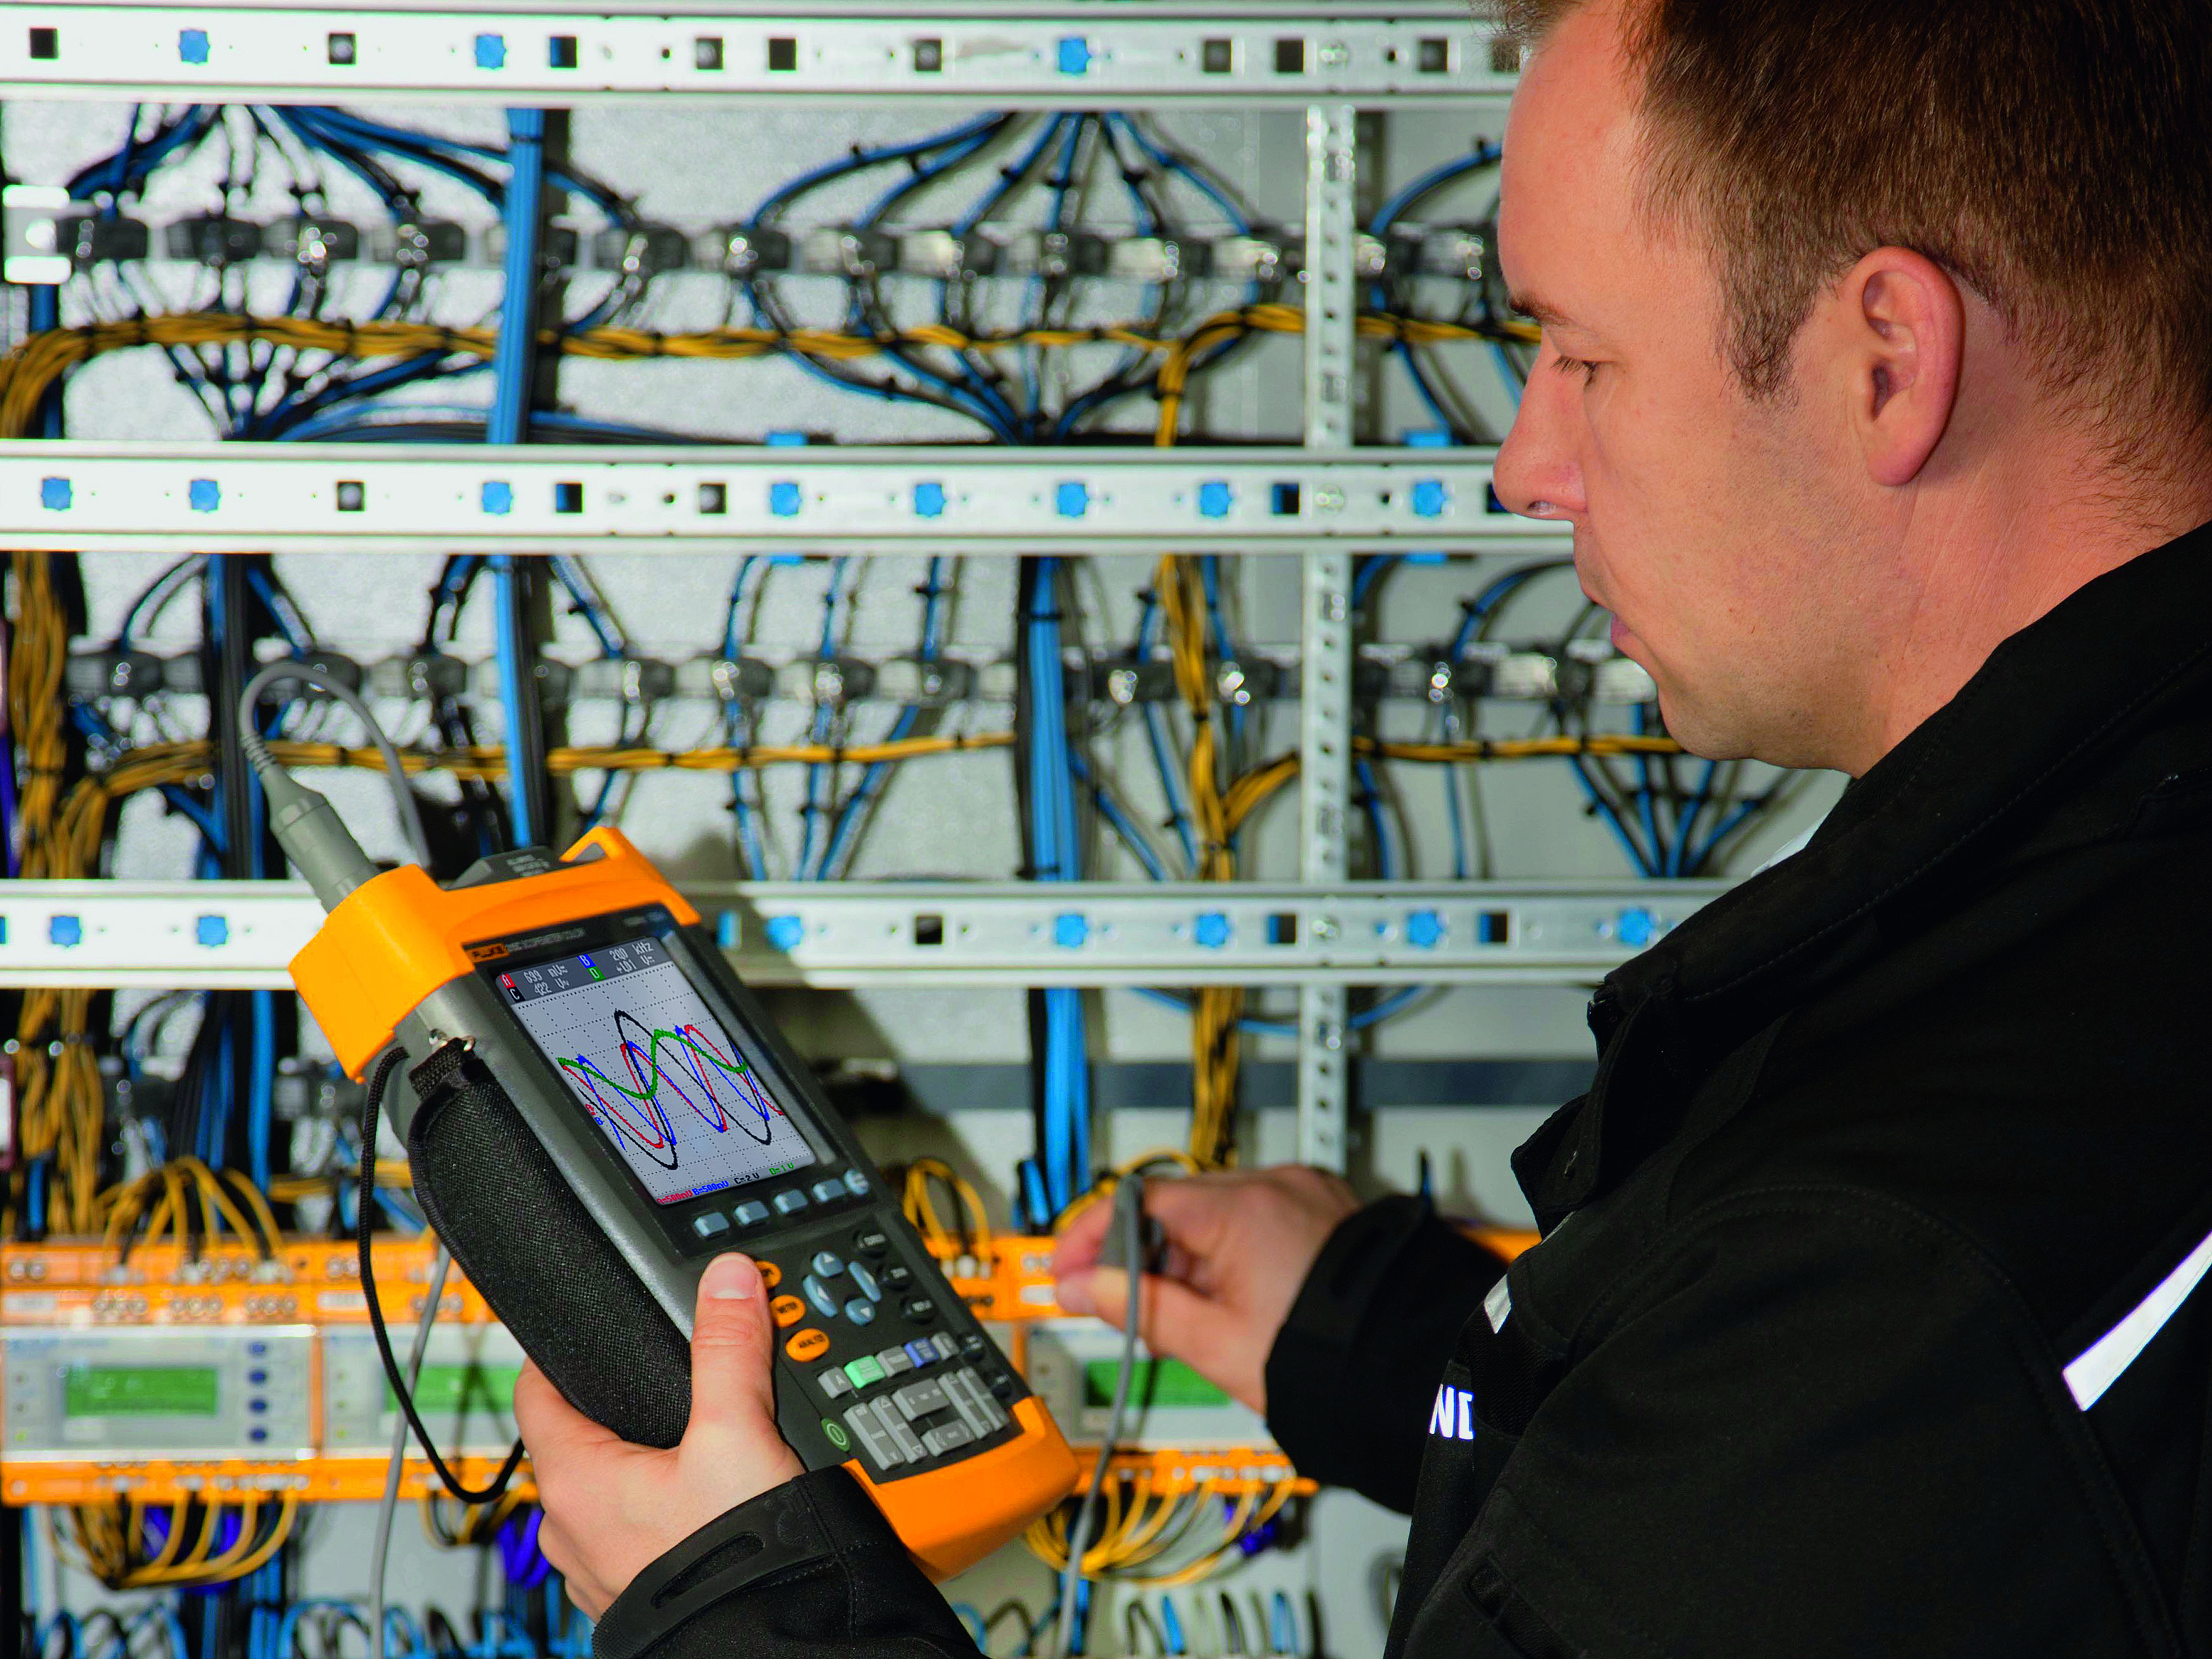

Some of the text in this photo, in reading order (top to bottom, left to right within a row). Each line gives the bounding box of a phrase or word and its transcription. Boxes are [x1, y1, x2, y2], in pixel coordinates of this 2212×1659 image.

[579, 955, 591, 966] B
[631, 941, 654, 955] kHz
[501, 974, 512, 987] A
[523, 970, 543, 984] 699
[589, 968, 600, 979] D
[510, 989, 520, 1001] C
